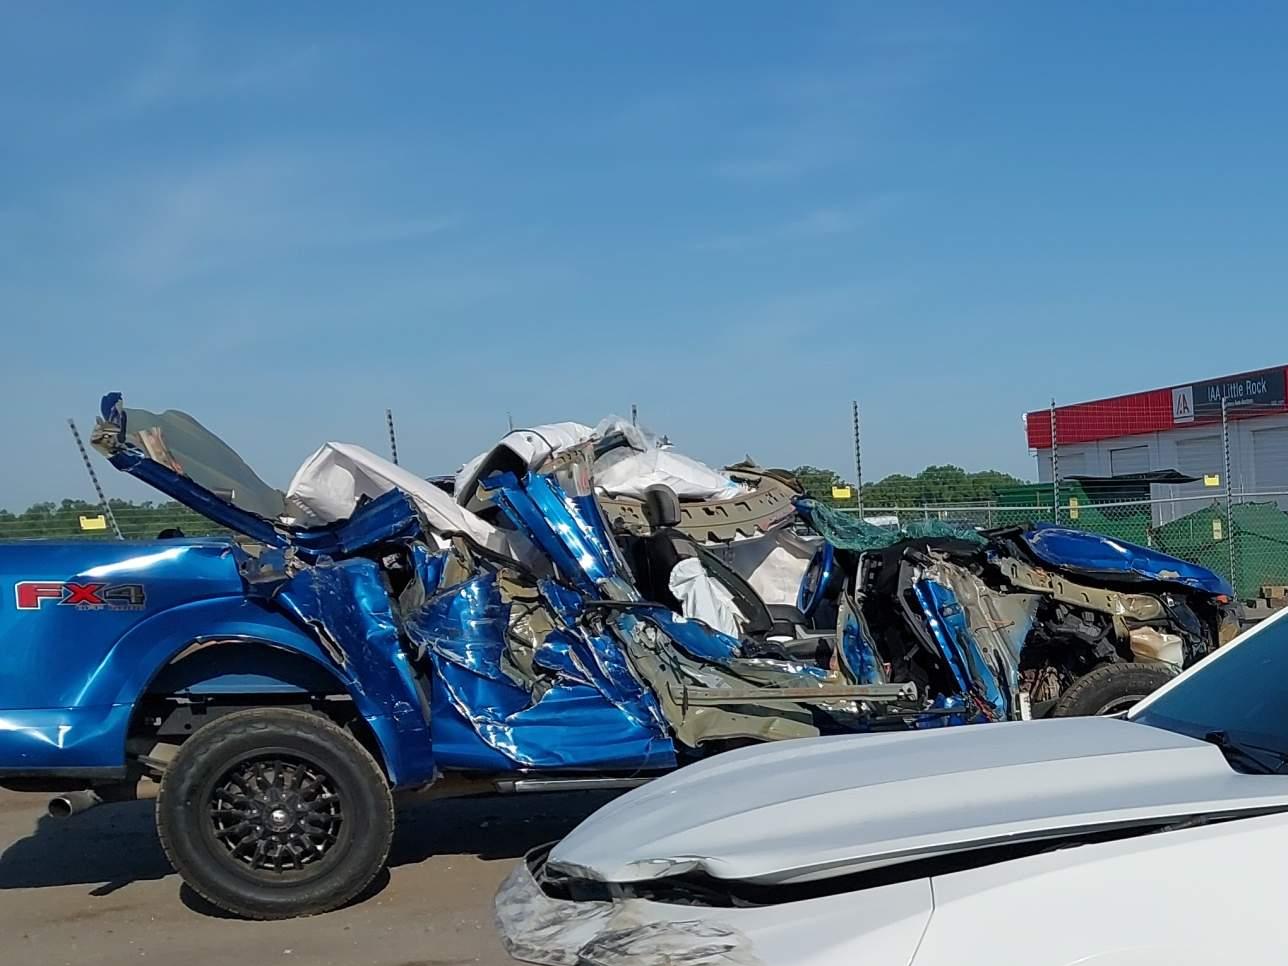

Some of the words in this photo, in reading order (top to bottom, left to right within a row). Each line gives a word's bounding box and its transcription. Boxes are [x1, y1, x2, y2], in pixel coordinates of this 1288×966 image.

[1207, 386, 1221, 401] IAA
[1223, 384, 1243, 399] Little
[1246, 379, 1267, 395] Rock
[15, 581, 146, 610] FX4
